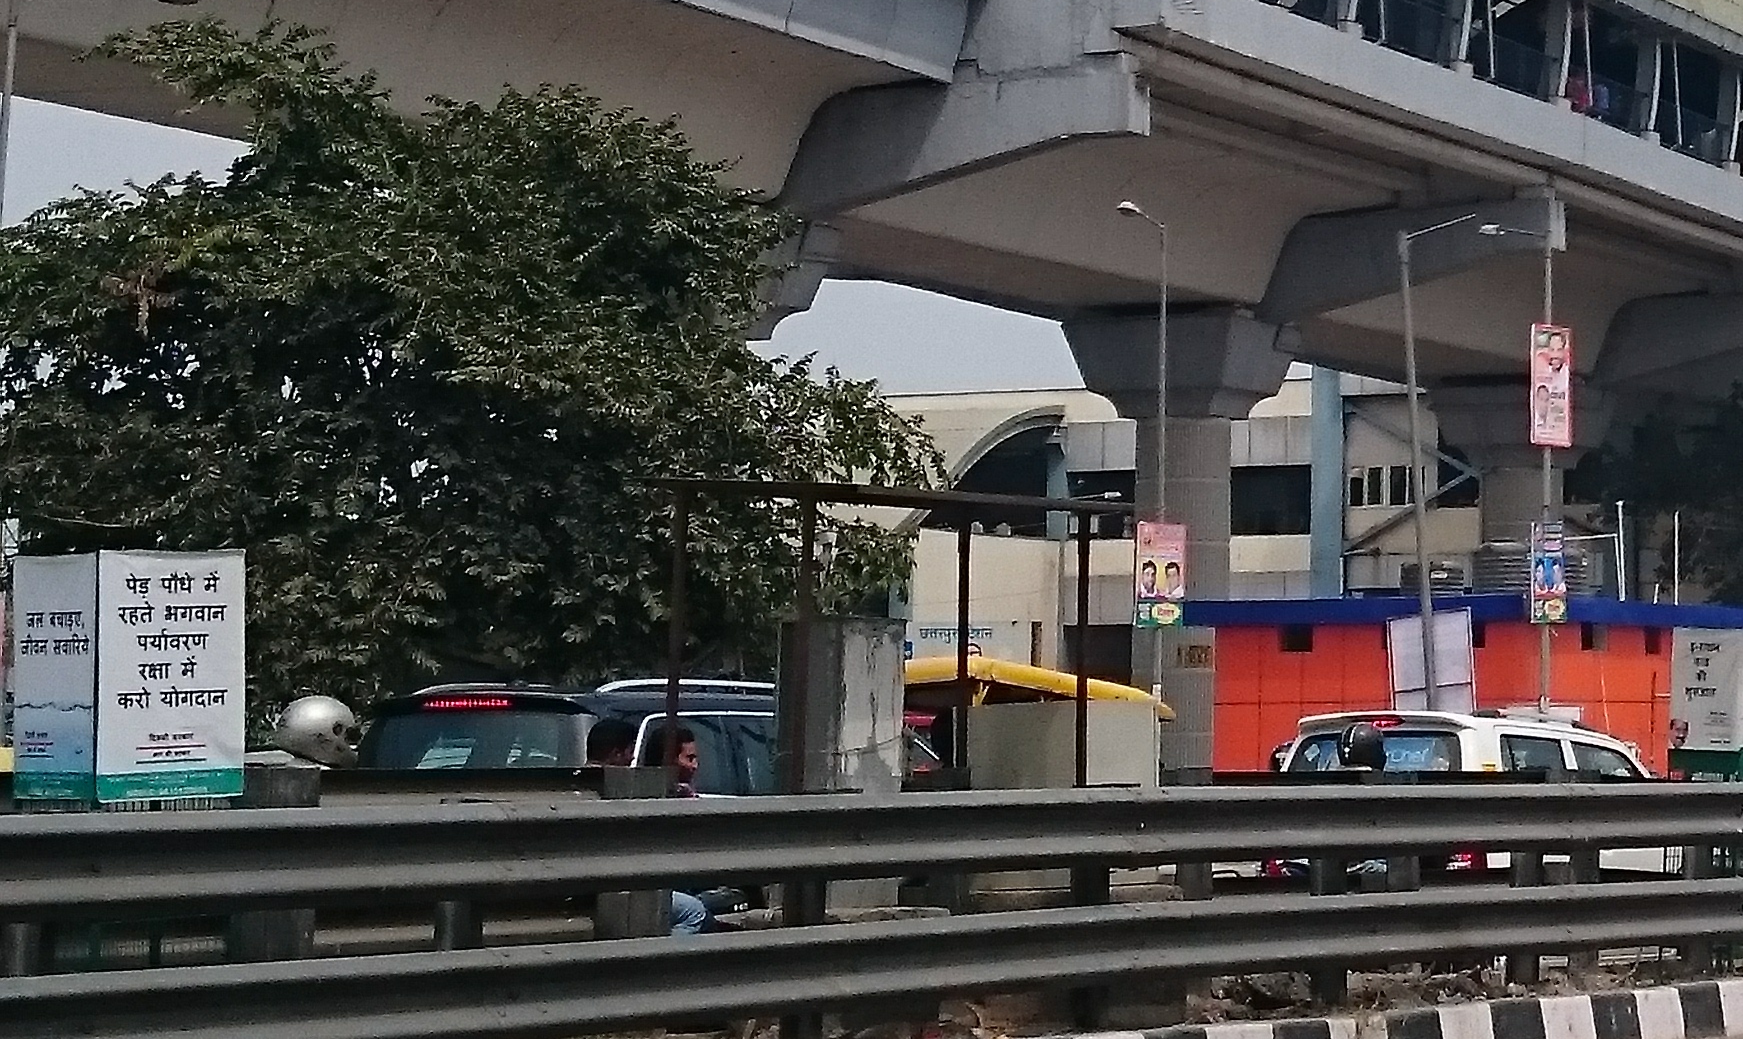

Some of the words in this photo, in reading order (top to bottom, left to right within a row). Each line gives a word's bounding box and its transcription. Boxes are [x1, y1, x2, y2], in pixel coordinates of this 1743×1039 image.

[126, 573, 151, 599] पेड़
[161, 572, 194, 593] पौधे
[203, 571, 220, 592] में
[118, 601, 155, 626] रहते
[164, 604, 227, 622] भगवान
[137, 628, 209, 651] पर्यावरण
[138, 662, 171, 680] रक्षा
[181, 656, 197, 678] में
[117, 687, 151, 709] करो
[160, 686, 228, 707] योगदान
